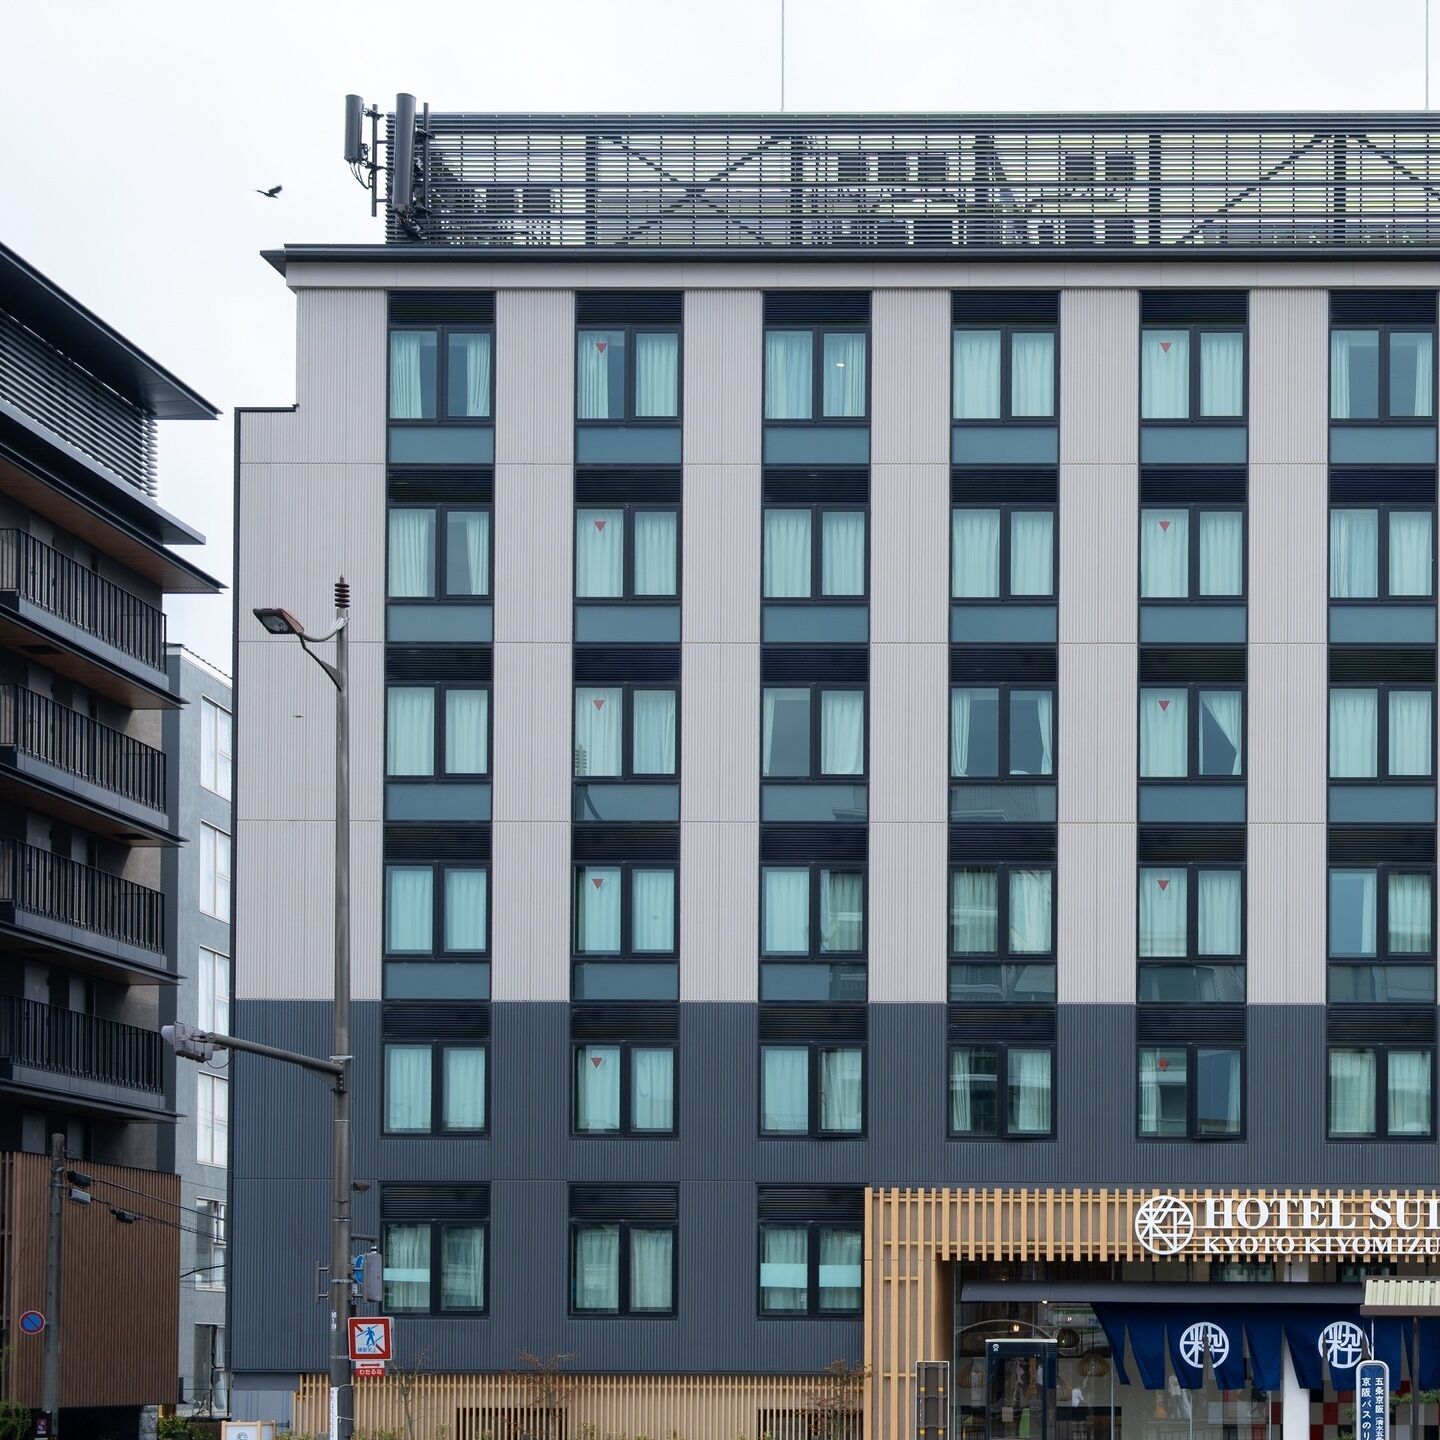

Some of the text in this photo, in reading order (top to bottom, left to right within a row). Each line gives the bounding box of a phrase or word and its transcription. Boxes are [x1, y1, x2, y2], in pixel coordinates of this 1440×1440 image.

[1203, 1198, 1356, 1230] HOTEL
[1204, 1237, 1295, 1254] KYOTO
[1361, 1377, 1372, 1440] 京阪バスのり
